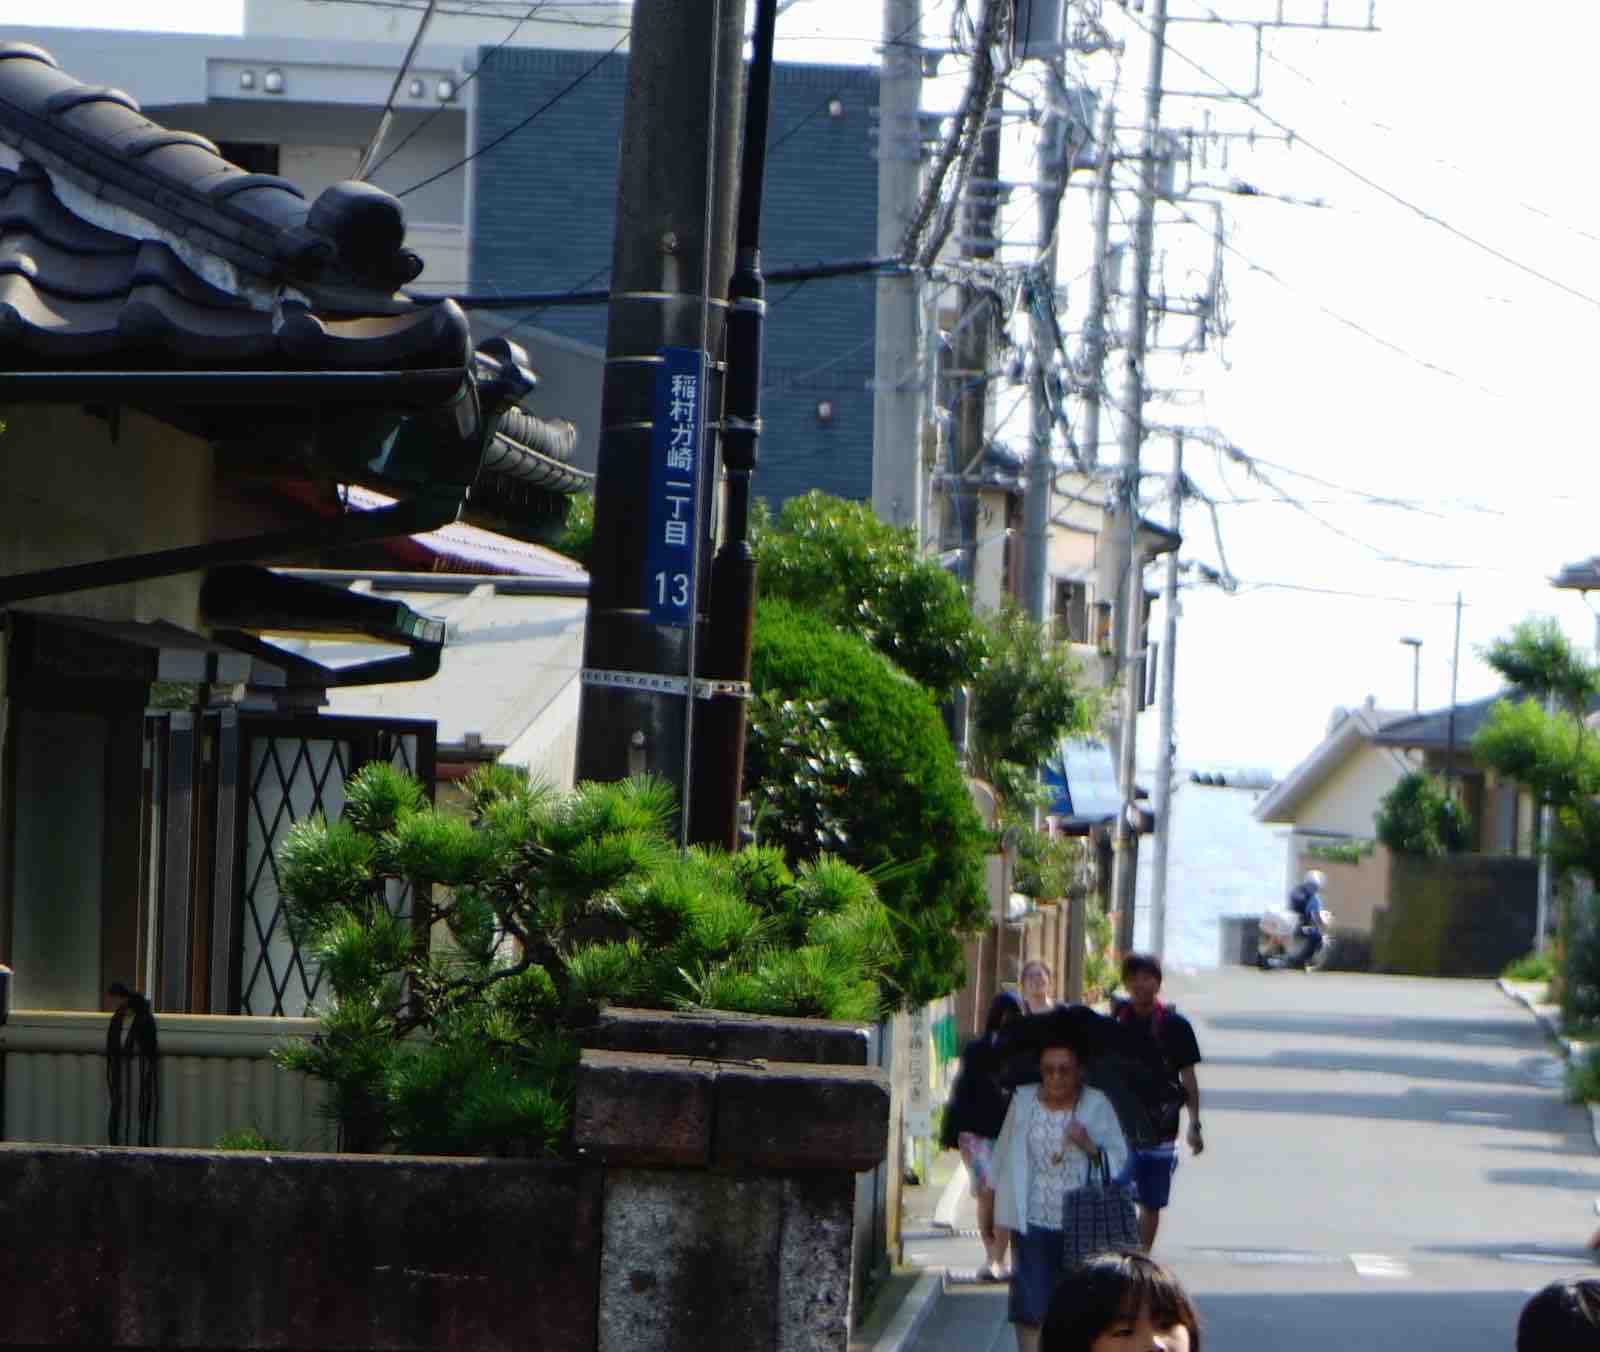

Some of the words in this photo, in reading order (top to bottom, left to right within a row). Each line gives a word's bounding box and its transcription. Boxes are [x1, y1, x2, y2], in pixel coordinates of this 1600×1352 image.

[665, 373, 697, 546] 稲村ガ崎一丁目
[655, 571, 689, 607] 13
